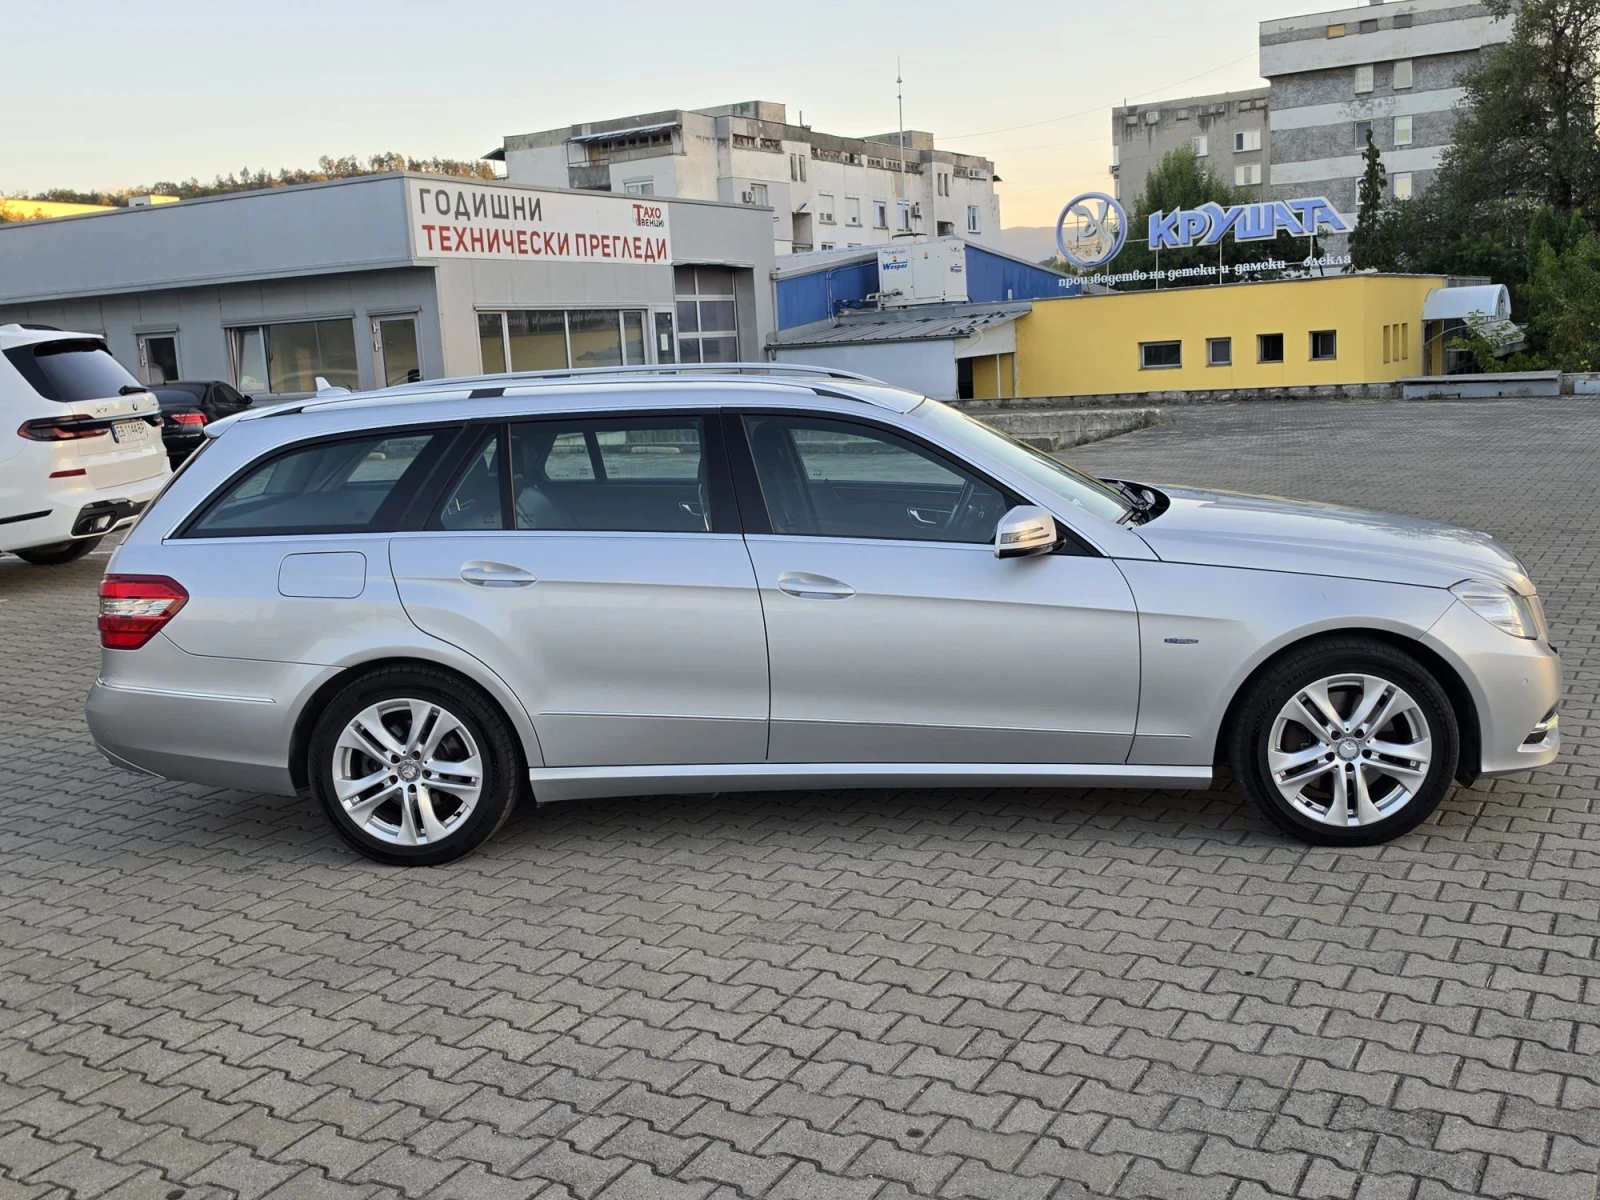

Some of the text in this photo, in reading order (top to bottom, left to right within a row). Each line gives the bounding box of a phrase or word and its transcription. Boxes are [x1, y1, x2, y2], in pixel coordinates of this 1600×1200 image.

[419, 188, 543, 222] ГОДИШНИ
[632, 203, 662, 226] ТАХО
[1149, 196, 1354, 250] КРУШАТА
[421, 224, 668, 263] ТЕХНИЧЕСКИ ПРЕГЛЕДИ
[882, 261, 908, 271] Wesper
[1149, 270, 1166, 280] на
[1220, 264, 1230, 274] и
